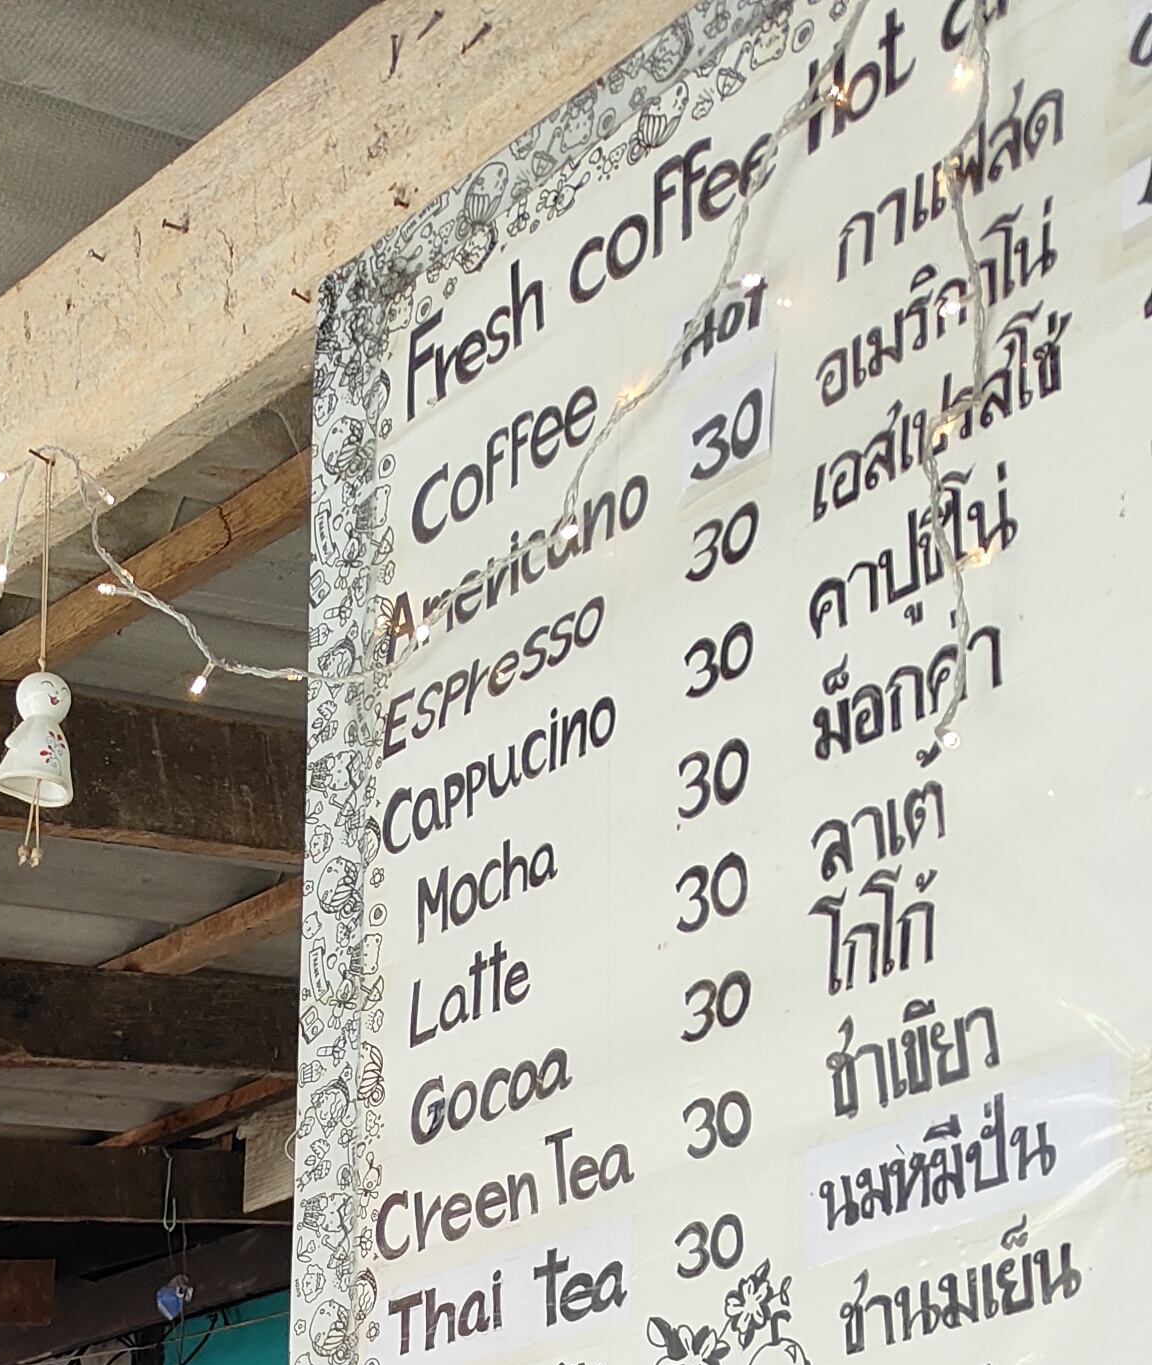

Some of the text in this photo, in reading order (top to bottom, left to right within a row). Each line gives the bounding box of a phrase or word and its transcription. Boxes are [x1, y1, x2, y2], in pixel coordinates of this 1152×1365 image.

[406, 9, 916, 422] Fresh coffee Hot
[837, 78, 1064, 283] กาแฟสด
[412, 385, 598, 544] Coffee
[690, 387, 763, 480] 30
[386, 473, 648, 646] Americano
[686, 503, 759, 582] 30
[383, 595, 605, 760] Espresso
[684, 621, 753, 698] 30
[383, 695, 616, 852] Cappucino
[678, 738, 749, 819] 30
[811, 741, 945, 882] ลาเต้
[416, 836, 558, 945] Mocha
[675, 852, 748, 934] 30
[808, 865, 938, 996] โกโก้
[409, 942, 531, 1049] Latte
[681, 971, 751, 1043] 30
[826, 999, 1000, 1119] ชาเขียว
[545, 1128, 635, 1205] Tea
[682, 1091, 751, 1158] 30
[675, 1214, 745, 1278] 30
[840, 1214, 1083, 1355] ชานมเย็น
[388, 1248, 628, 1356] Thai tea
